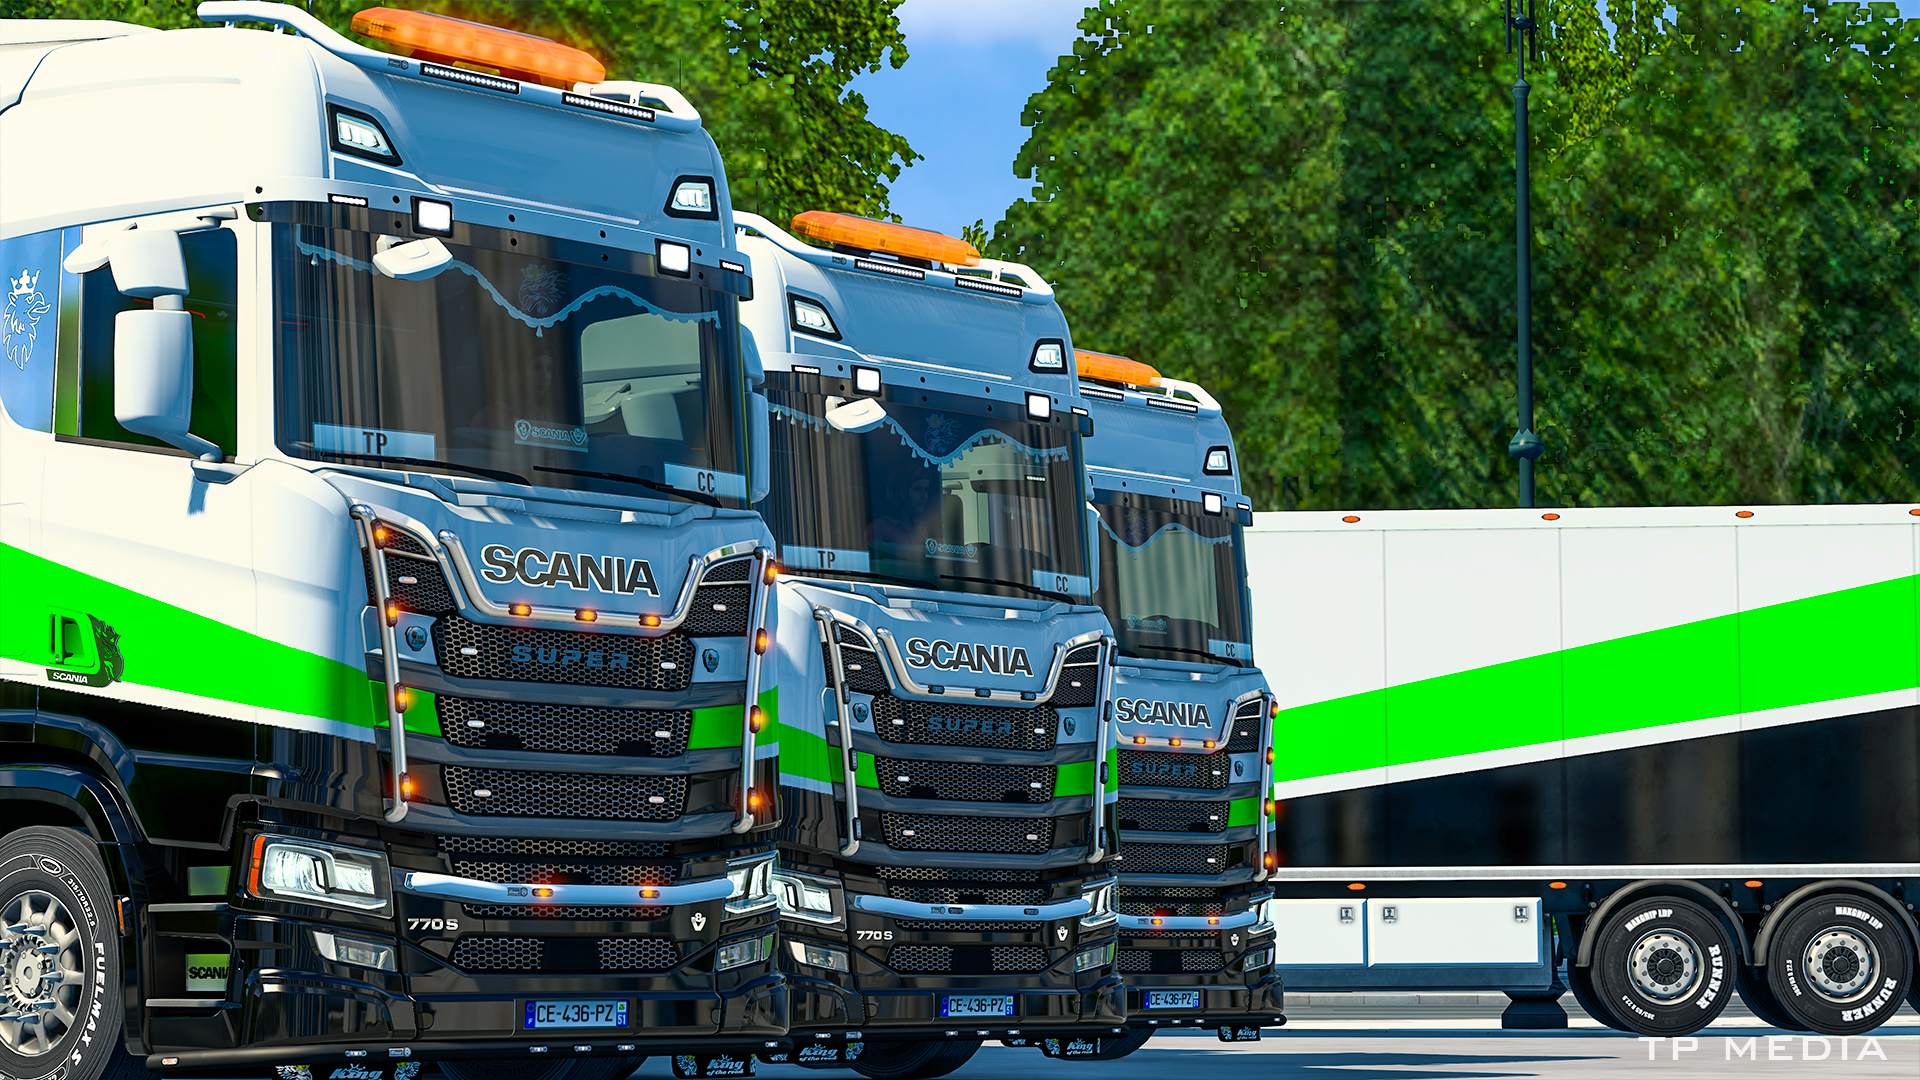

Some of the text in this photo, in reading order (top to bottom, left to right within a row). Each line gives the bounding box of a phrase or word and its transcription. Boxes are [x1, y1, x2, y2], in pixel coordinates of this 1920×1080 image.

[362, 431, 388, 455] TP
[531, 426, 571, 441] SCANIA
[697, 471, 715, 493] CC
[817, 550, 836, 569] TP
[481, 544, 660, 597] SCANIA
[1055, 575, 1068, 593] CC
[512, 645, 630, 670] SUPER
[906, 638, 1034, 677] SCANIA
[1225, 643, 1236, 657] CC
[52, 672, 88, 684] SCANIA
[1115, 697, 1213, 729] SCANIA
[929, 716, 1013, 736] SUPER
[1132, 762, 1196, 776] SUPER
[407, 918, 459, 931] 770 S
[1625, 909, 1658, 932] MAXGRIP
[1835, 906, 1870, 921] MAXGRIP
[1868, 916, 1884, 930] LDP
[856, 930, 893, 941] 770 S
[1696, 944, 1723, 1010] RUNNER
[71, 942, 105, 1066] FUELMAX S
[949, 998, 1004, 1013] CE-436-PZ
[1150, 993, 1192, 1006] CE-436-PZ
[1841, 977, 1897, 1021] RUNNER
[537, 1004, 613, 1023] CE-436-PZ
[617, 1014, 626, 1025] 51
[799, 1046, 839, 1058] King
[707, 1058, 745, 1070] King
